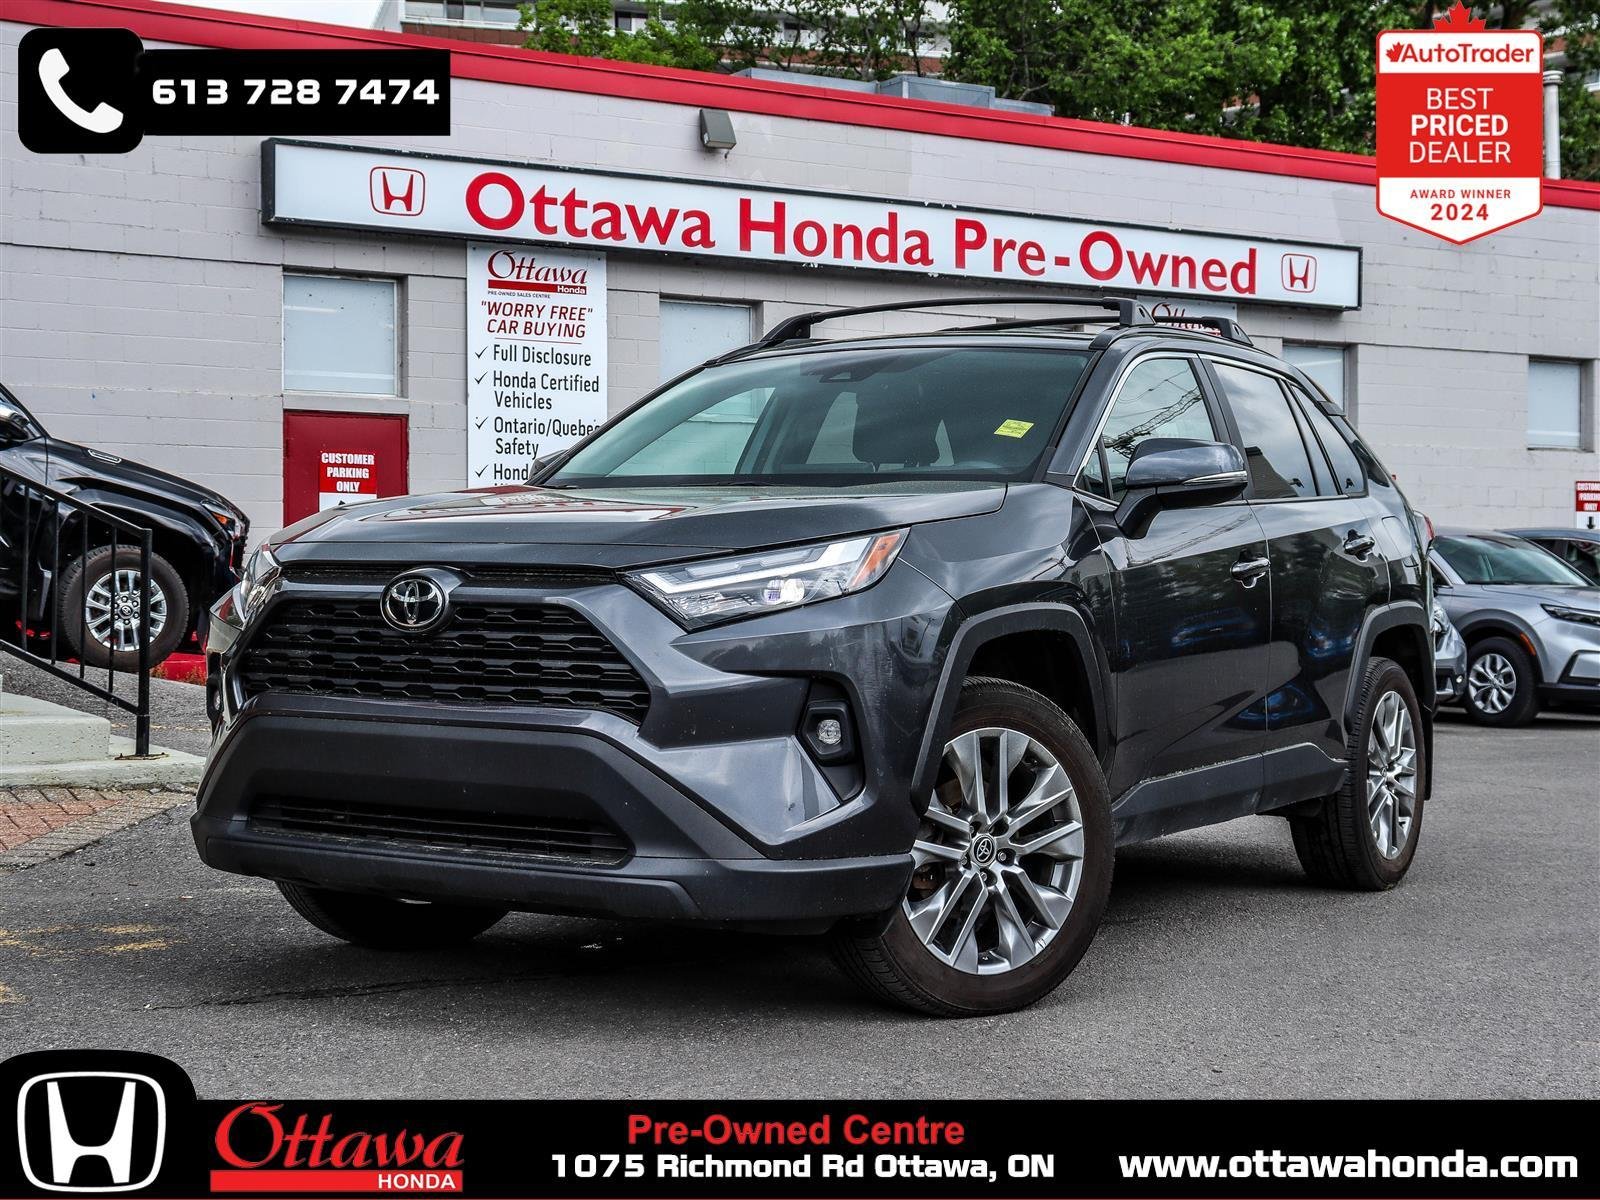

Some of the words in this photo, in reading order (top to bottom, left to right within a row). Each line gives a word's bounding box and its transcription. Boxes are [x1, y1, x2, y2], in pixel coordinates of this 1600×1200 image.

[465, 171, 716, 249] Ottawa
[739, 198, 934, 267] Honda
[955, 218, 1257, 294] Pre-Owned
[487, 249, 588, 285] Ottawa
[557, 285, 586, 295] Honda
[481, 301, 546, 318] "WORRY
[550, 305, 593, 321] FREE"
[487, 319, 519, 335] CAR
[523, 321, 586, 339] BUYING
[493, 344, 517, 362] Full
[522, 346, 592, 366] Disclosure
[493, 370, 536, 388] Honda
[541, 373, 599, 392] Certified
[494, 391, 552, 410] Vehicles
[321, 453, 375, 465] CUSTOMER
[495, 438, 539, 460] Safety
[326, 466, 370, 479] PARKING
[493, 463, 529, 481] Hond
[336, 481, 360, 492] ONLY
